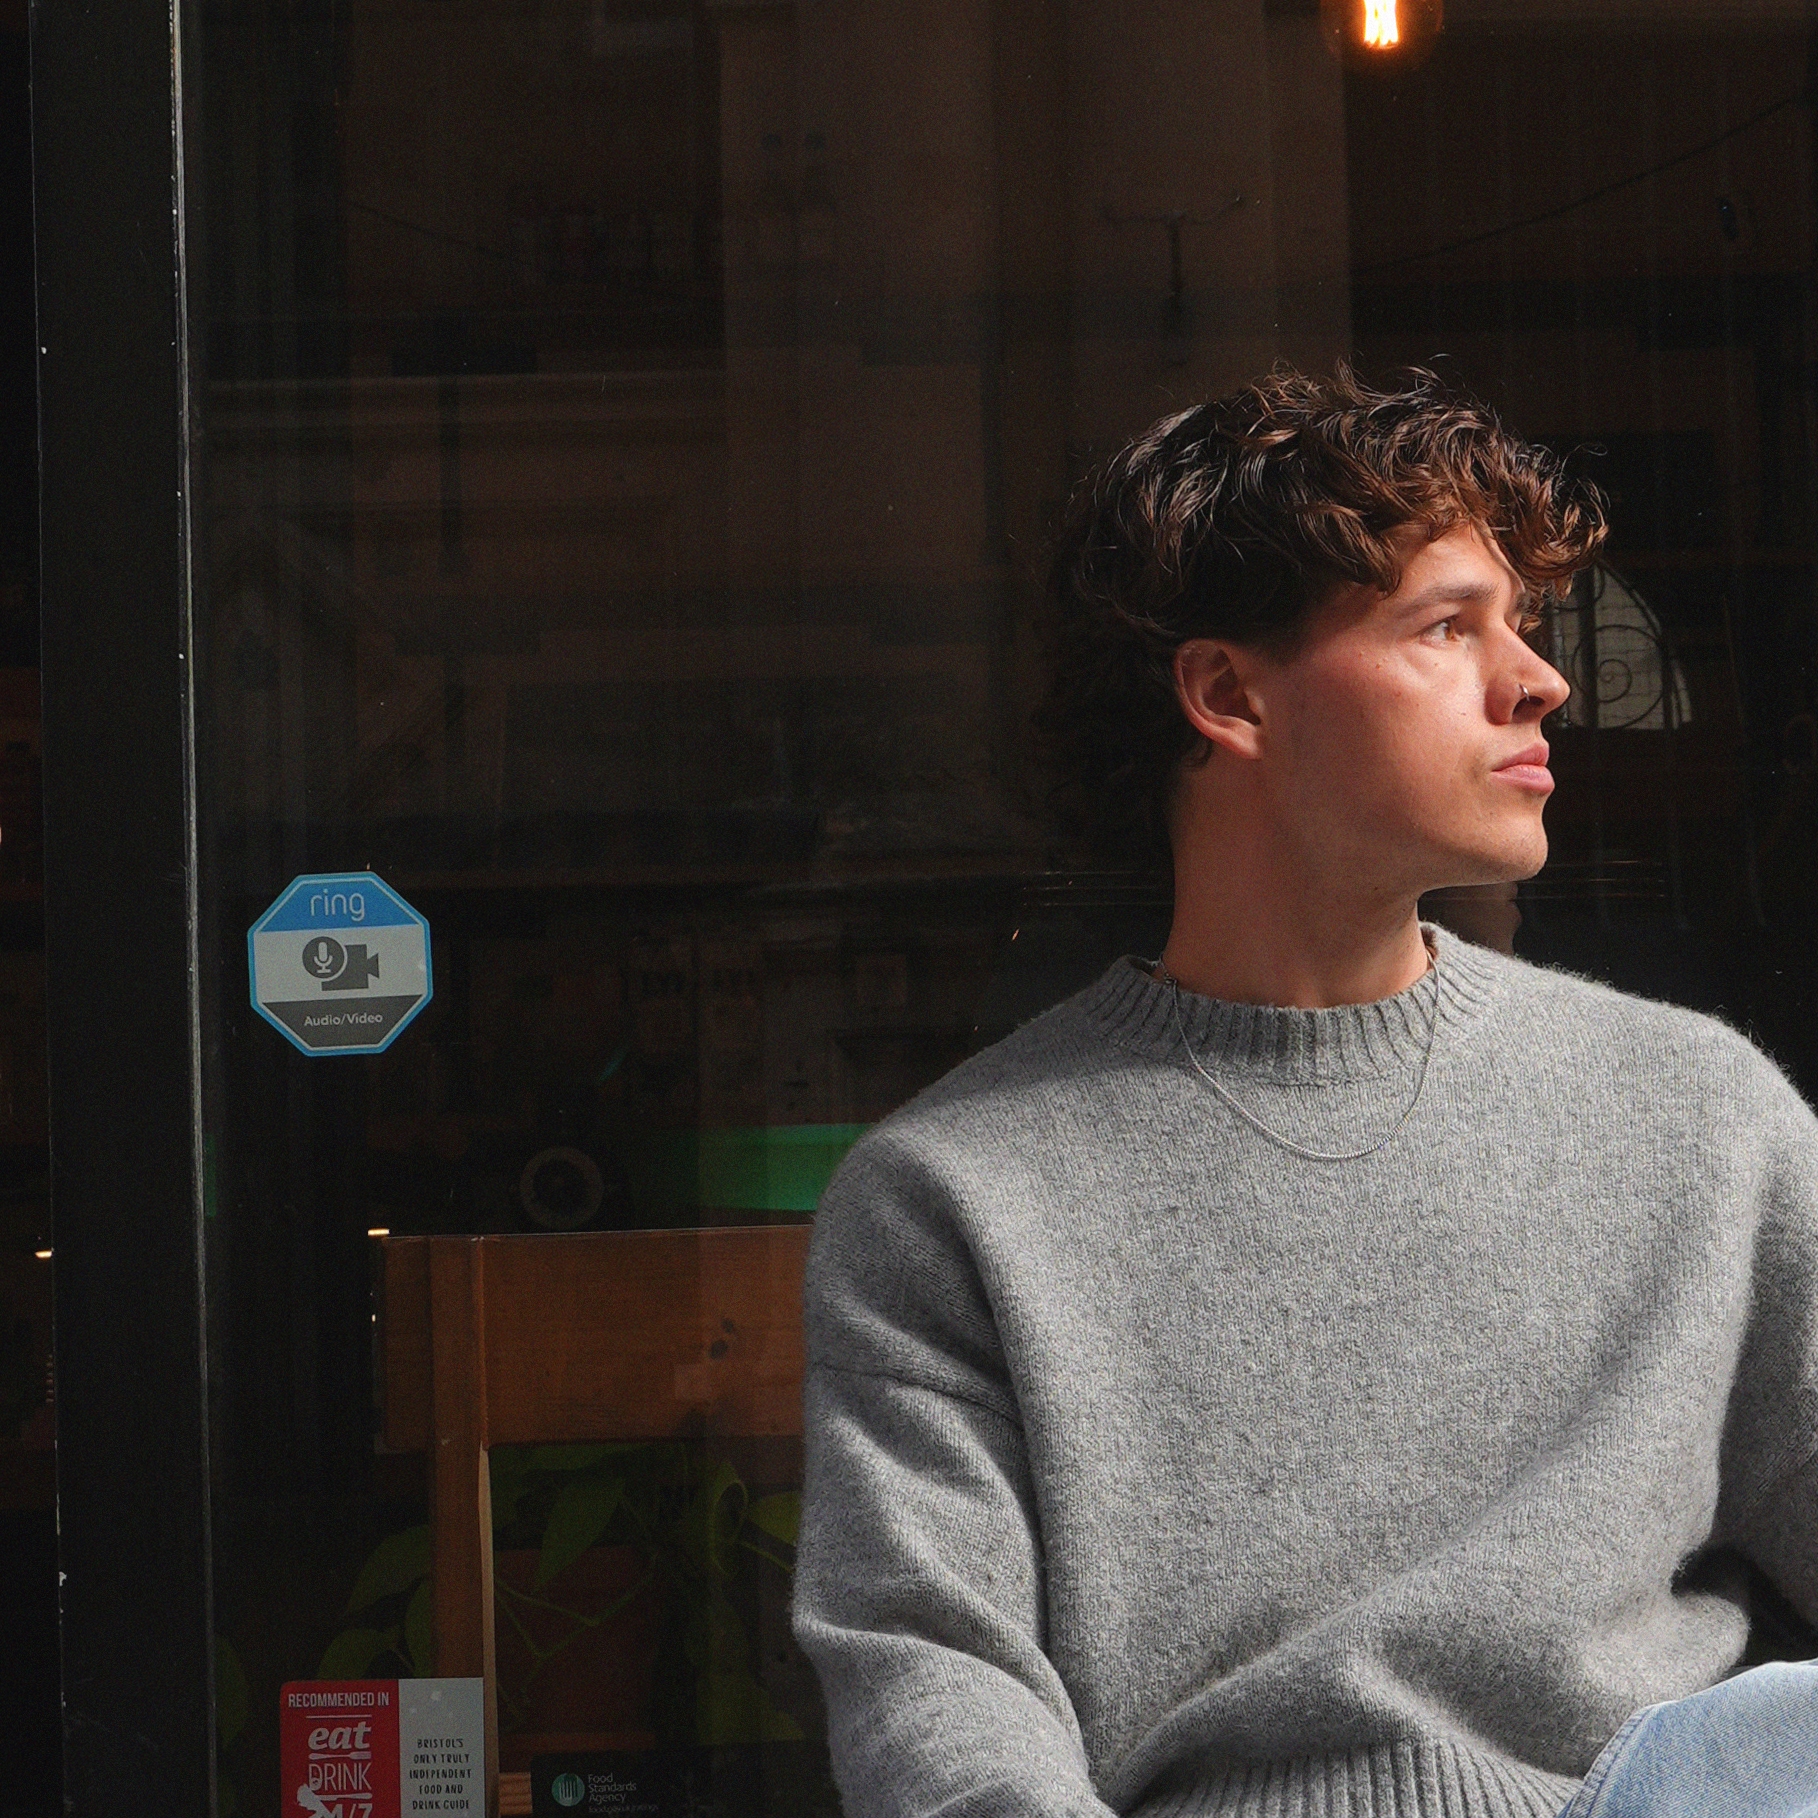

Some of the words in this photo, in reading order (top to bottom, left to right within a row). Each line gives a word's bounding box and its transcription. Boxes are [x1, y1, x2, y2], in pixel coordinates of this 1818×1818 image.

[310, 888, 365, 922] ring
[304, 1013, 383, 1027] Audio/Video
[288, 1694, 375, 1708] RECOMMENDED
[377, 1692, 389, 1706] IN
[308, 1721, 371, 1750] eat
[417, 1738, 464, 1748] BRISTOL'S
[413, 1754, 437, 1764] ONLY
[441, 1753, 470, 1763] TRULY
[308, 1762, 371, 1791] DRINK
[409, 1769, 472, 1779] INDEPENDENT
[588, 1773, 613, 1782] Food
[419, 1785, 442, 1795] FOOD
[445, 1784, 463, 1794] AND
[588, 1781, 637, 1793] Standards
[588, 1793, 626, 1804] Agency
[412, 1800, 441, 1810] DRINK
[443, 1799, 470, 1810] GUIDE
